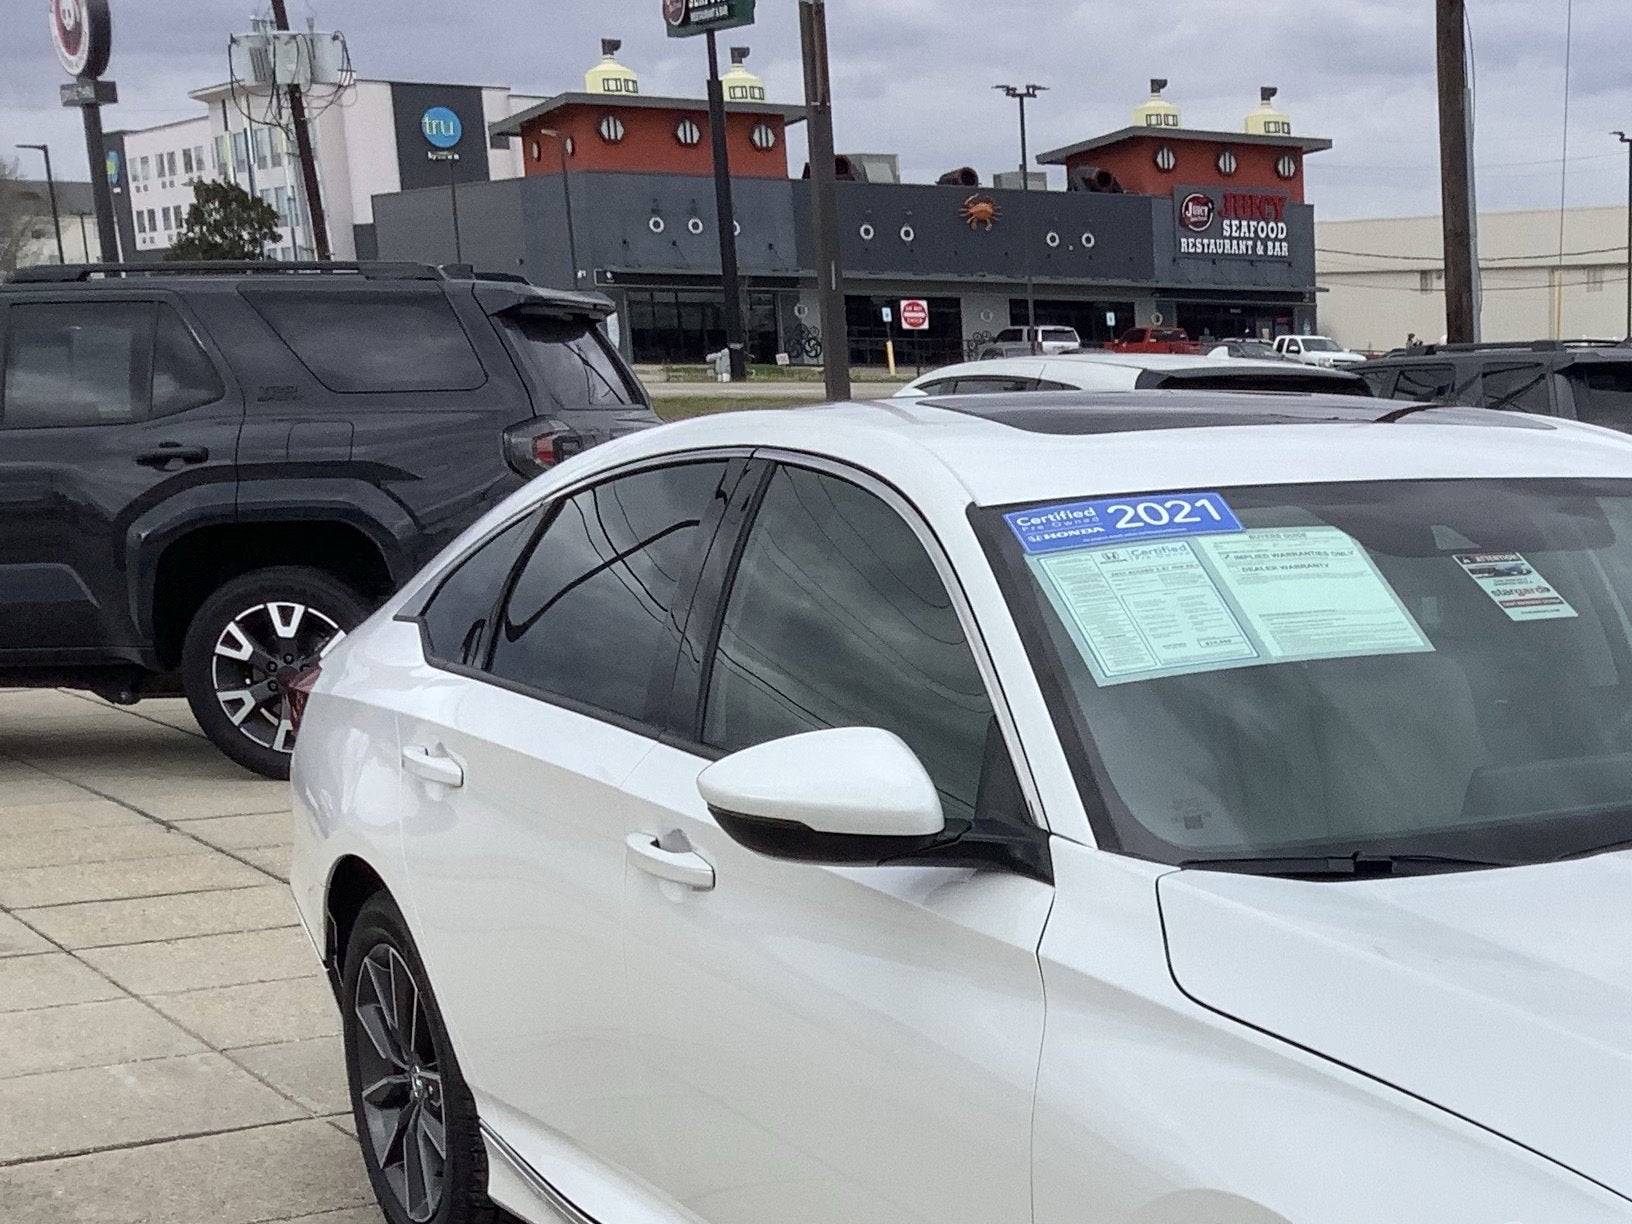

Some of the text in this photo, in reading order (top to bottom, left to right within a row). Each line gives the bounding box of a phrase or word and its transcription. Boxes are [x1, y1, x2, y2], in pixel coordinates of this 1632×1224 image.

[422, 114, 455, 137] tru
[1218, 193, 1288, 221] JUICY
[1222, 219, 1287, 239] SEAFOOD
[1180, 238, 1289, 257] RESTAURANT & BAR
[1016, 507, 1097, 527] Certified
[1106, 498, 1222, 529] 2021
[1043, 526, 1106, 541] HONDA
[1130, 544, 1188, 557] Certified
[1234, 552, 1270, 561] IMPLIED
[1272, 550, 1329, 559] WARRANTIES
[1242, 563, 1329, 573] DEALER WARRANTY
